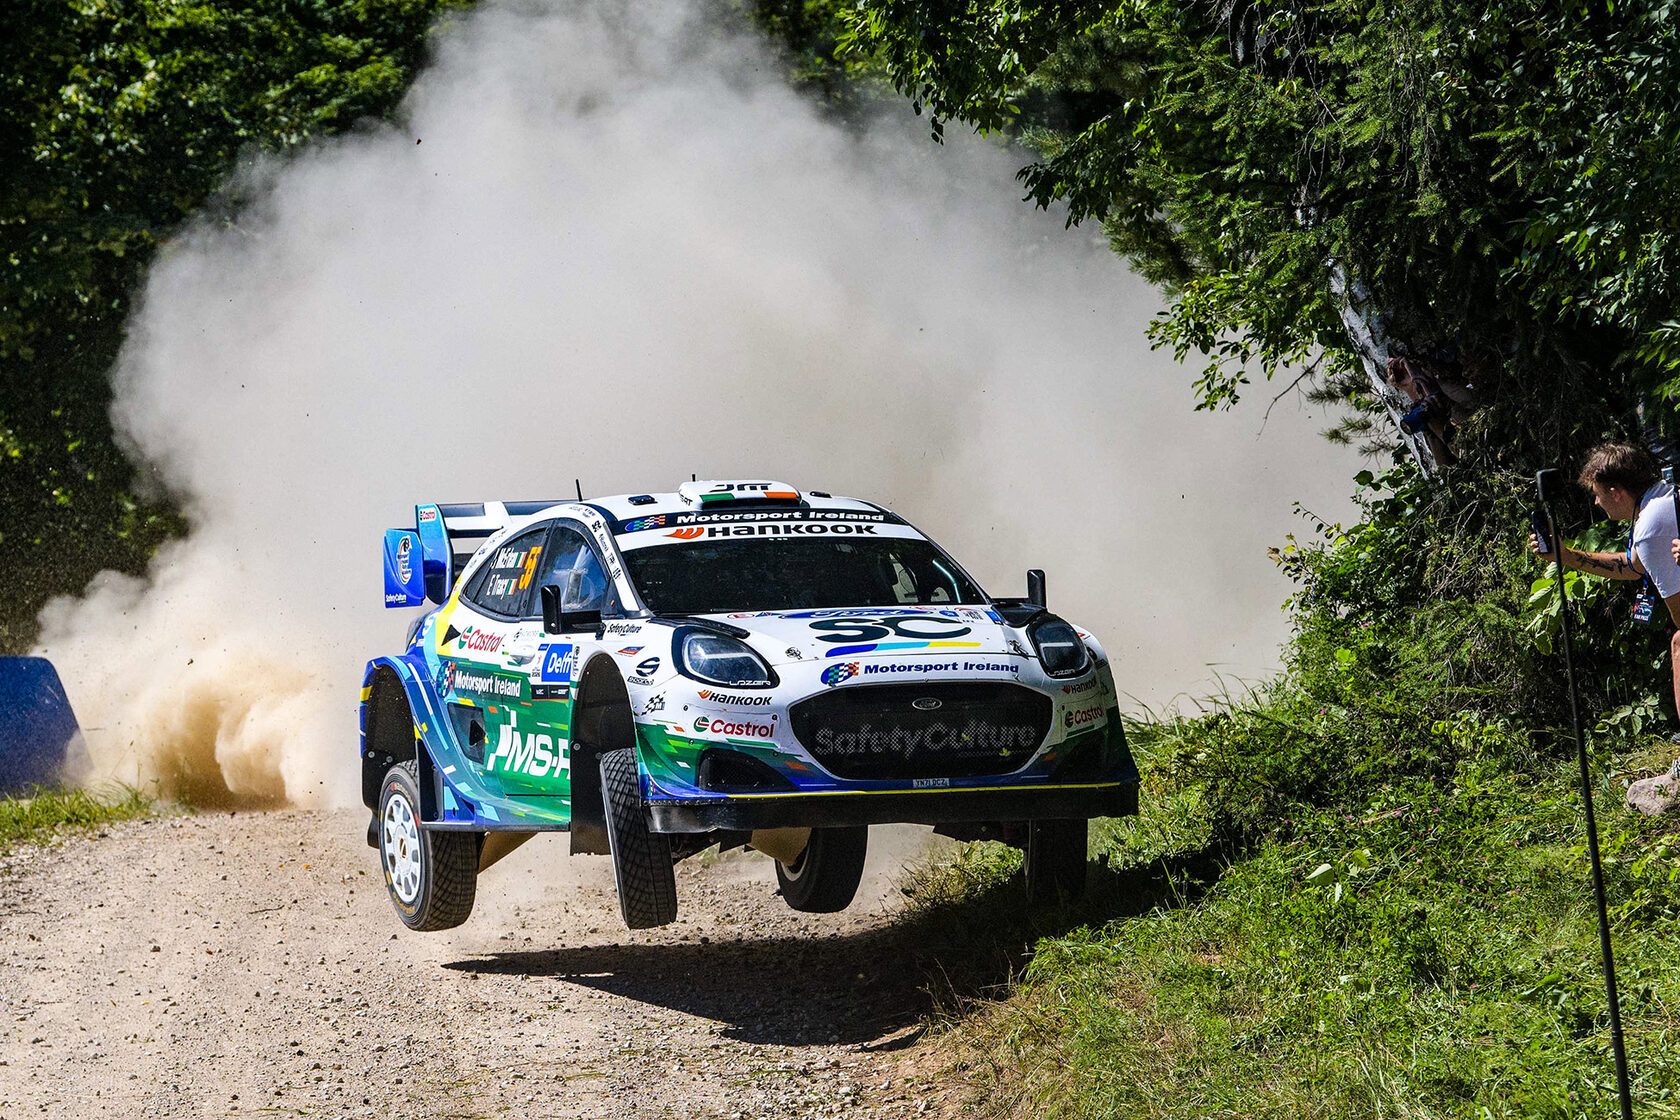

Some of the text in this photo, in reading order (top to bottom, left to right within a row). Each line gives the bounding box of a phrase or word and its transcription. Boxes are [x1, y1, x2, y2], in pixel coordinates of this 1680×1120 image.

[677, 511, 884, 524] Motorsport Ireland
[518, 546, 543, 590] 55
[486, 574, 496, 596] E
[809, 616, 972, 643] SC
[468, 629, 505, 653] Castrol
[864, 662, 1019, 675] Motorsport Ireland
[454, 670, 522, 698] Motorsport Ireland
[709, 692, 773, 706] Hankook
[1074, 705, 1105, 725] Castrol
[710, 719, 775, 738] Castrol
[815, 719, 1037, 761] SafetyCulture
